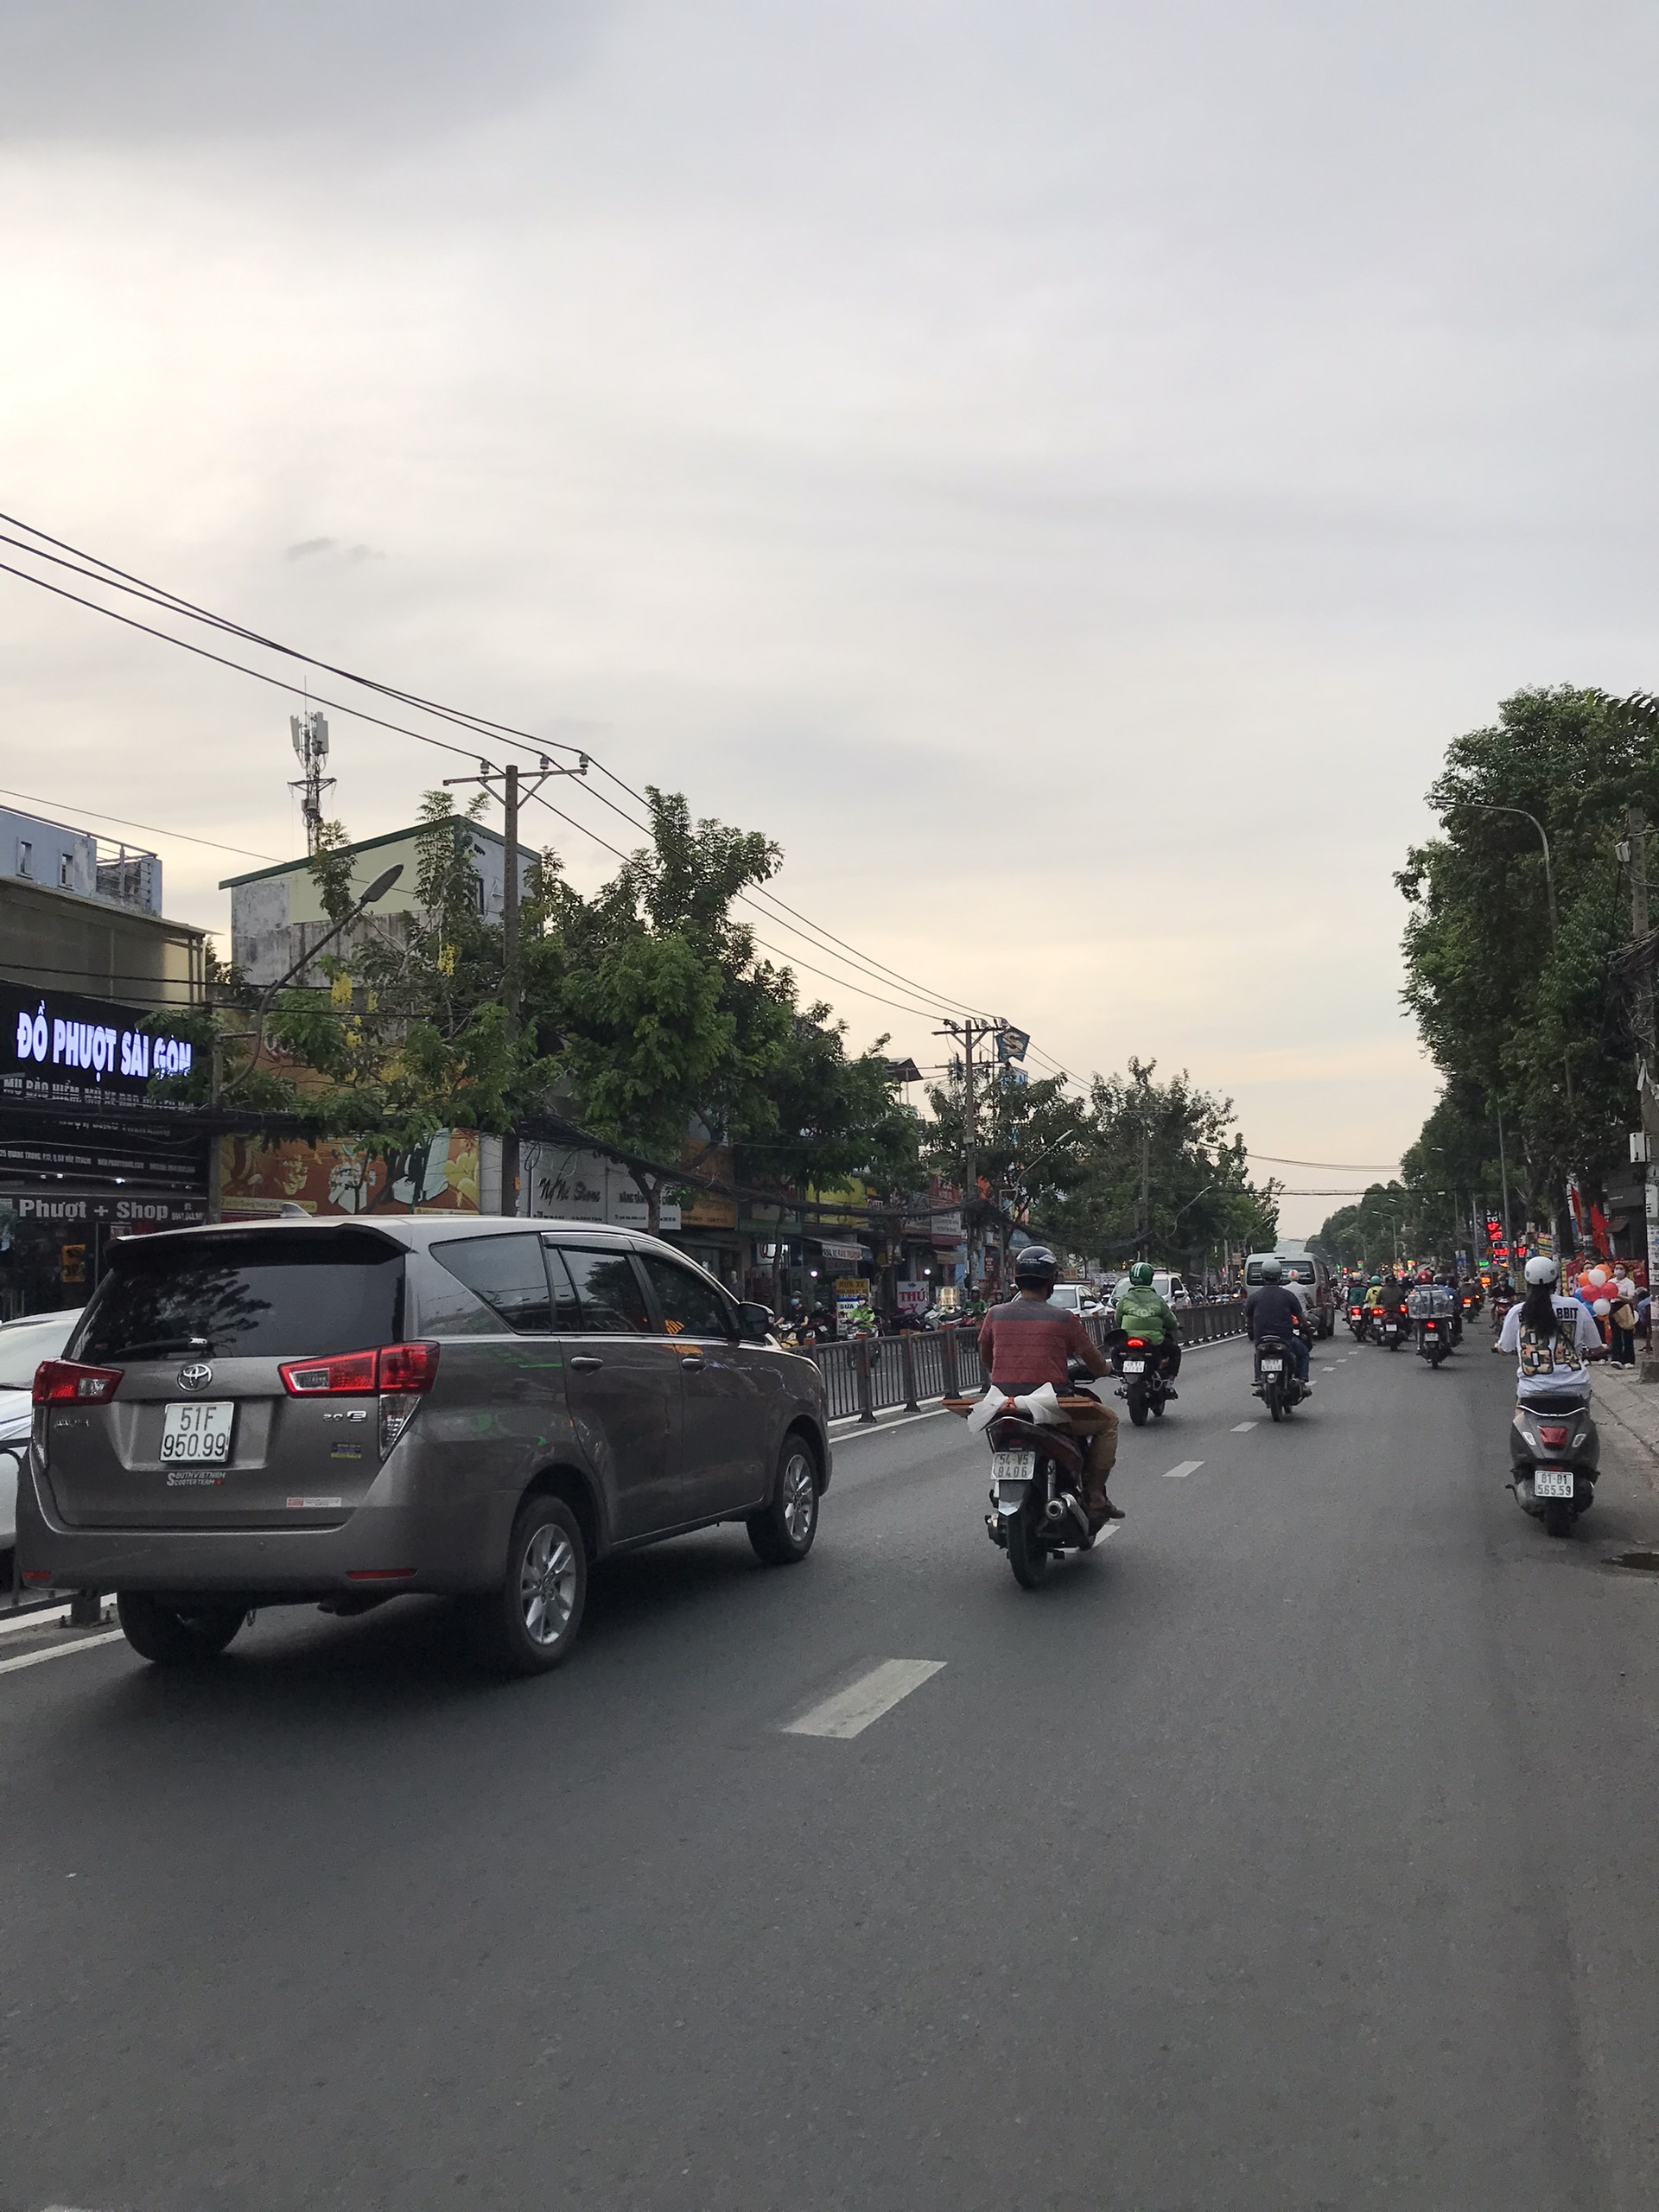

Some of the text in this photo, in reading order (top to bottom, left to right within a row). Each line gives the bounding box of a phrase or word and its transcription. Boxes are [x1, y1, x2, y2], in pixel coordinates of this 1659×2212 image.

[53, 1018, 117, 1082] PHƯỢT
[121, 1028, 149, 1077] SÀI
[153, 1035, 192, 1079] GÒN
[19, 1199, 86, 1221] Phượt
[117, 1202, 168, 1221] Shop
[899, 1287, 926, 1302] THÚ
[181, 1407, 217, 1431] 51F
[163, 1433, 226, 1457] 950.99
[998, 1466, 1027, 1478] 8406
[1538, 1484, 1571, 1496] 565.59
